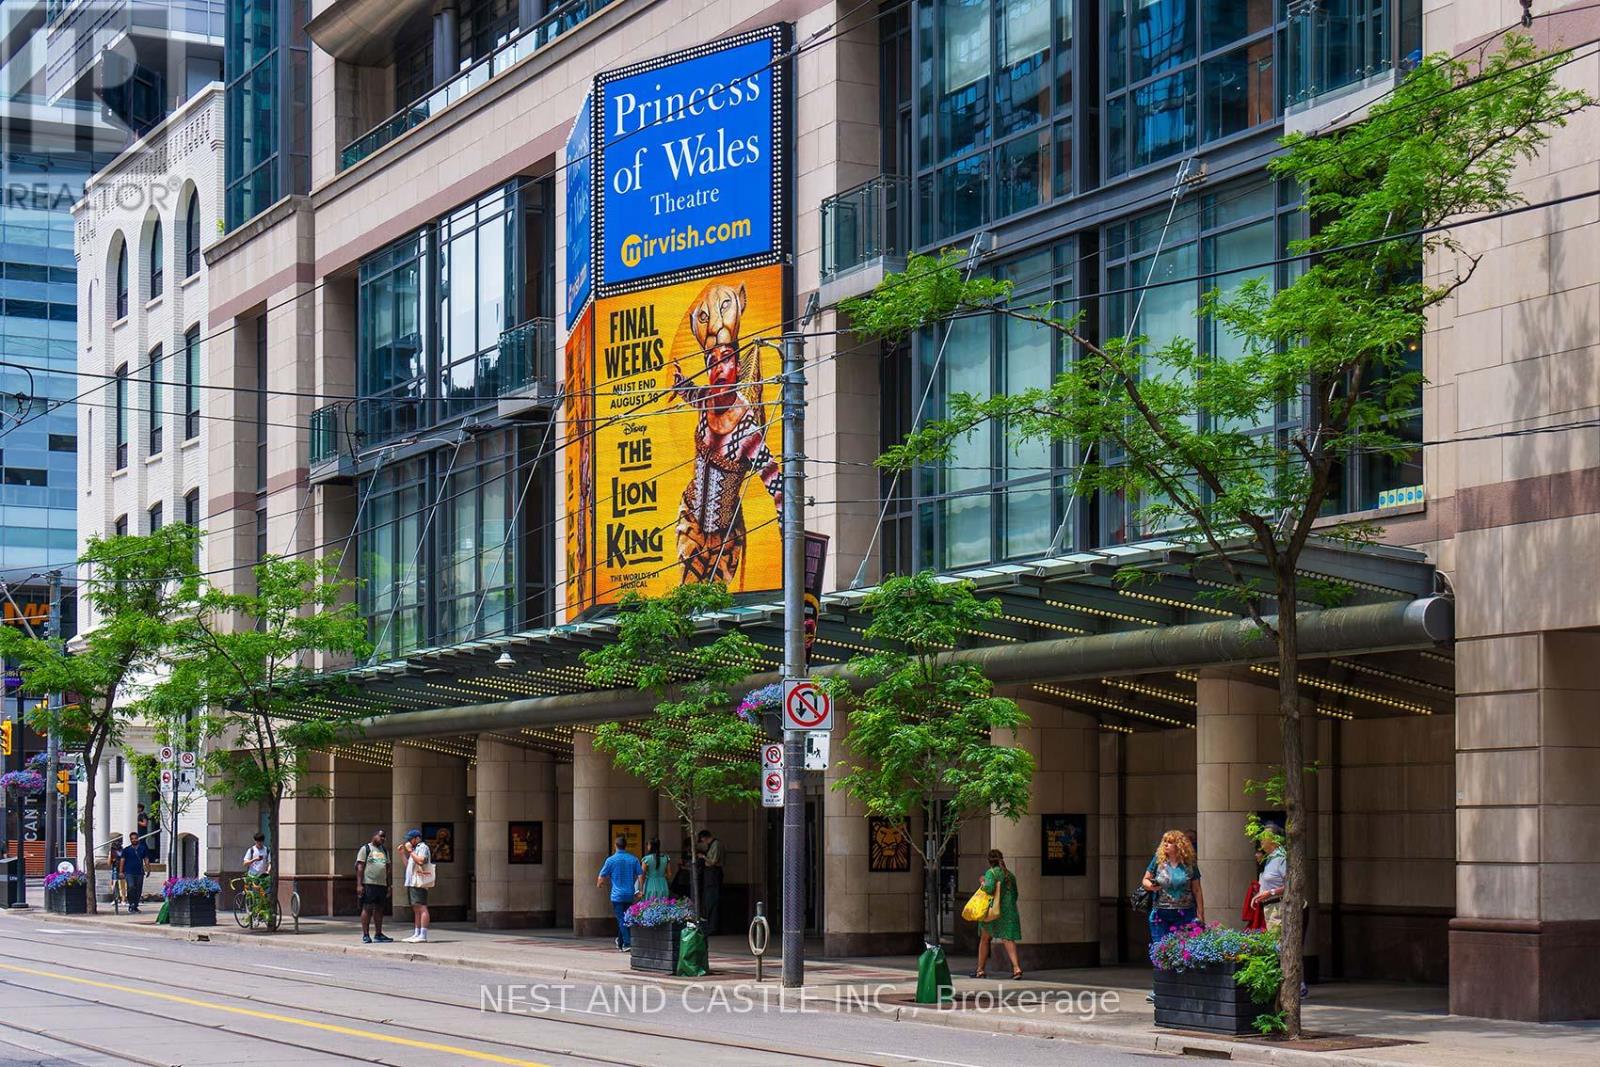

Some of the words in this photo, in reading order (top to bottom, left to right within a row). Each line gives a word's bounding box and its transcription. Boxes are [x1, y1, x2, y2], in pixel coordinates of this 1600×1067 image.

[613, 73, 760, 137] Princess
[613, 147, 647, 194] of
[662, 127, 760, 181] Wales
[650, 187, 720, 216] Theatre
[621, 218, 751, 267] mirvish.com
[610, 304, 659, 345] FINAL
[604, 338, 664, 379] WEEKS
[610, 394, 646, 409] AUGUST
[613, 382, 636, 393] MUST
[639, 379, 656, 390] END
[622, 423, 647, 436] Disney
[617, 438, 652, 465] THE
[612, 477, 657, 518] LION
[606, 523, 663, 568] KING
